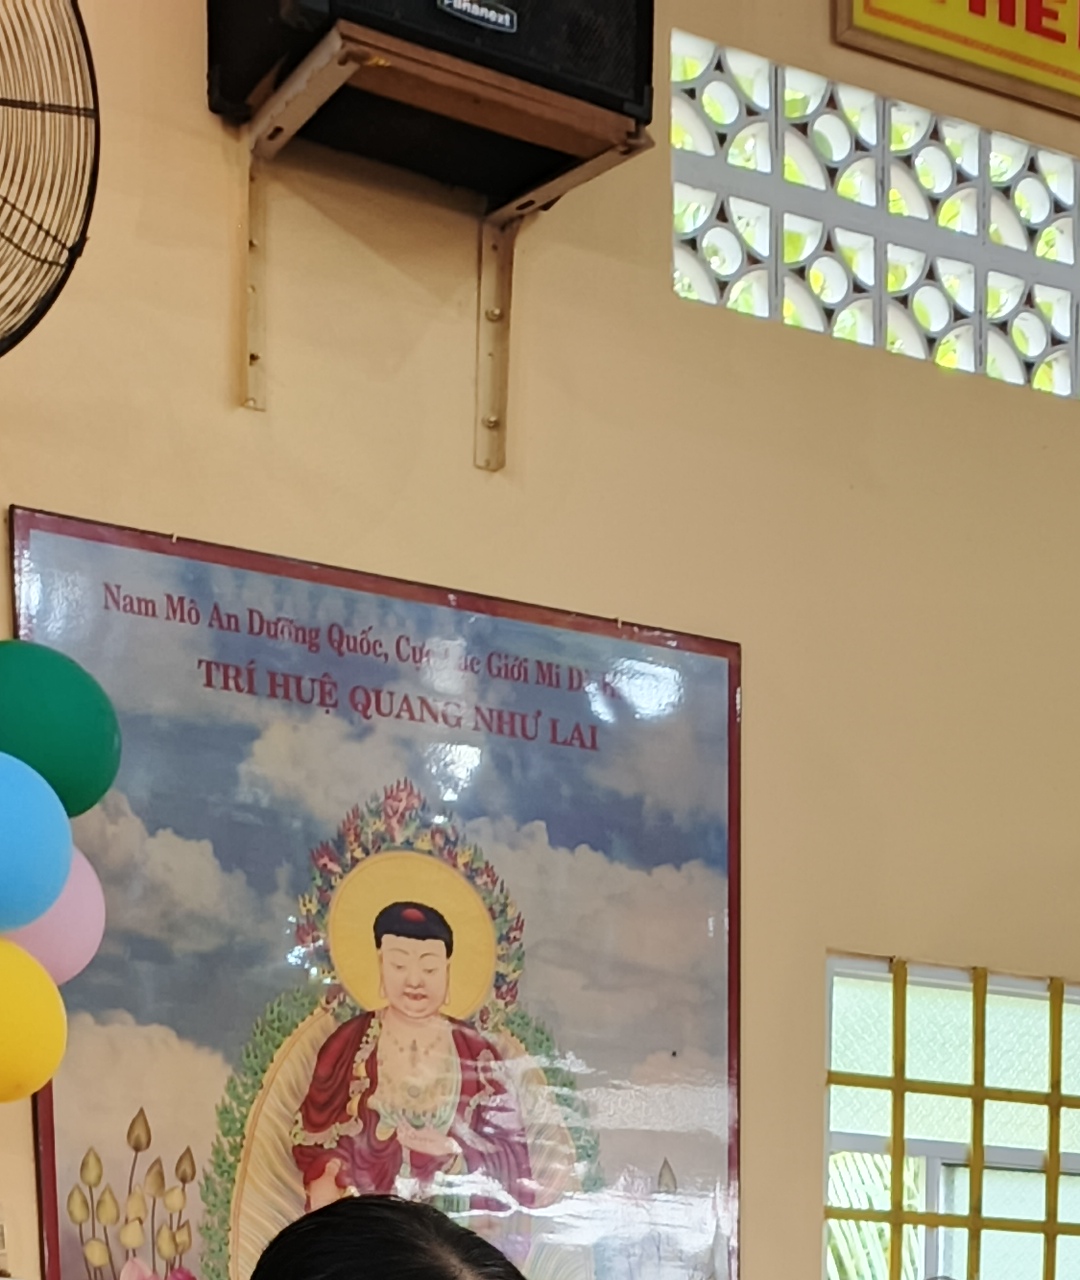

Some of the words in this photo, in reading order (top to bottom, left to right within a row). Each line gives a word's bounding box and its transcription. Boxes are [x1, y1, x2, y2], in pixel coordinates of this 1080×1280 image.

[103, 581, 158, 618] Nam
[164, 592, 201, 626] Mô
[207, 602, 241, 634] An
[326, 622, 389, 663] Quốc,
[487, 651, 529, 684] Giới
[535, 660, 561, 688] Mi
[197, 659, 258, 696] TRÍ
[266, 669, 339, 714] HUỆ
[349, 685, 463, 730] QUANG
[472, 705, 543, 741] NHƯ
[549, 717, 599, 751] LAI
